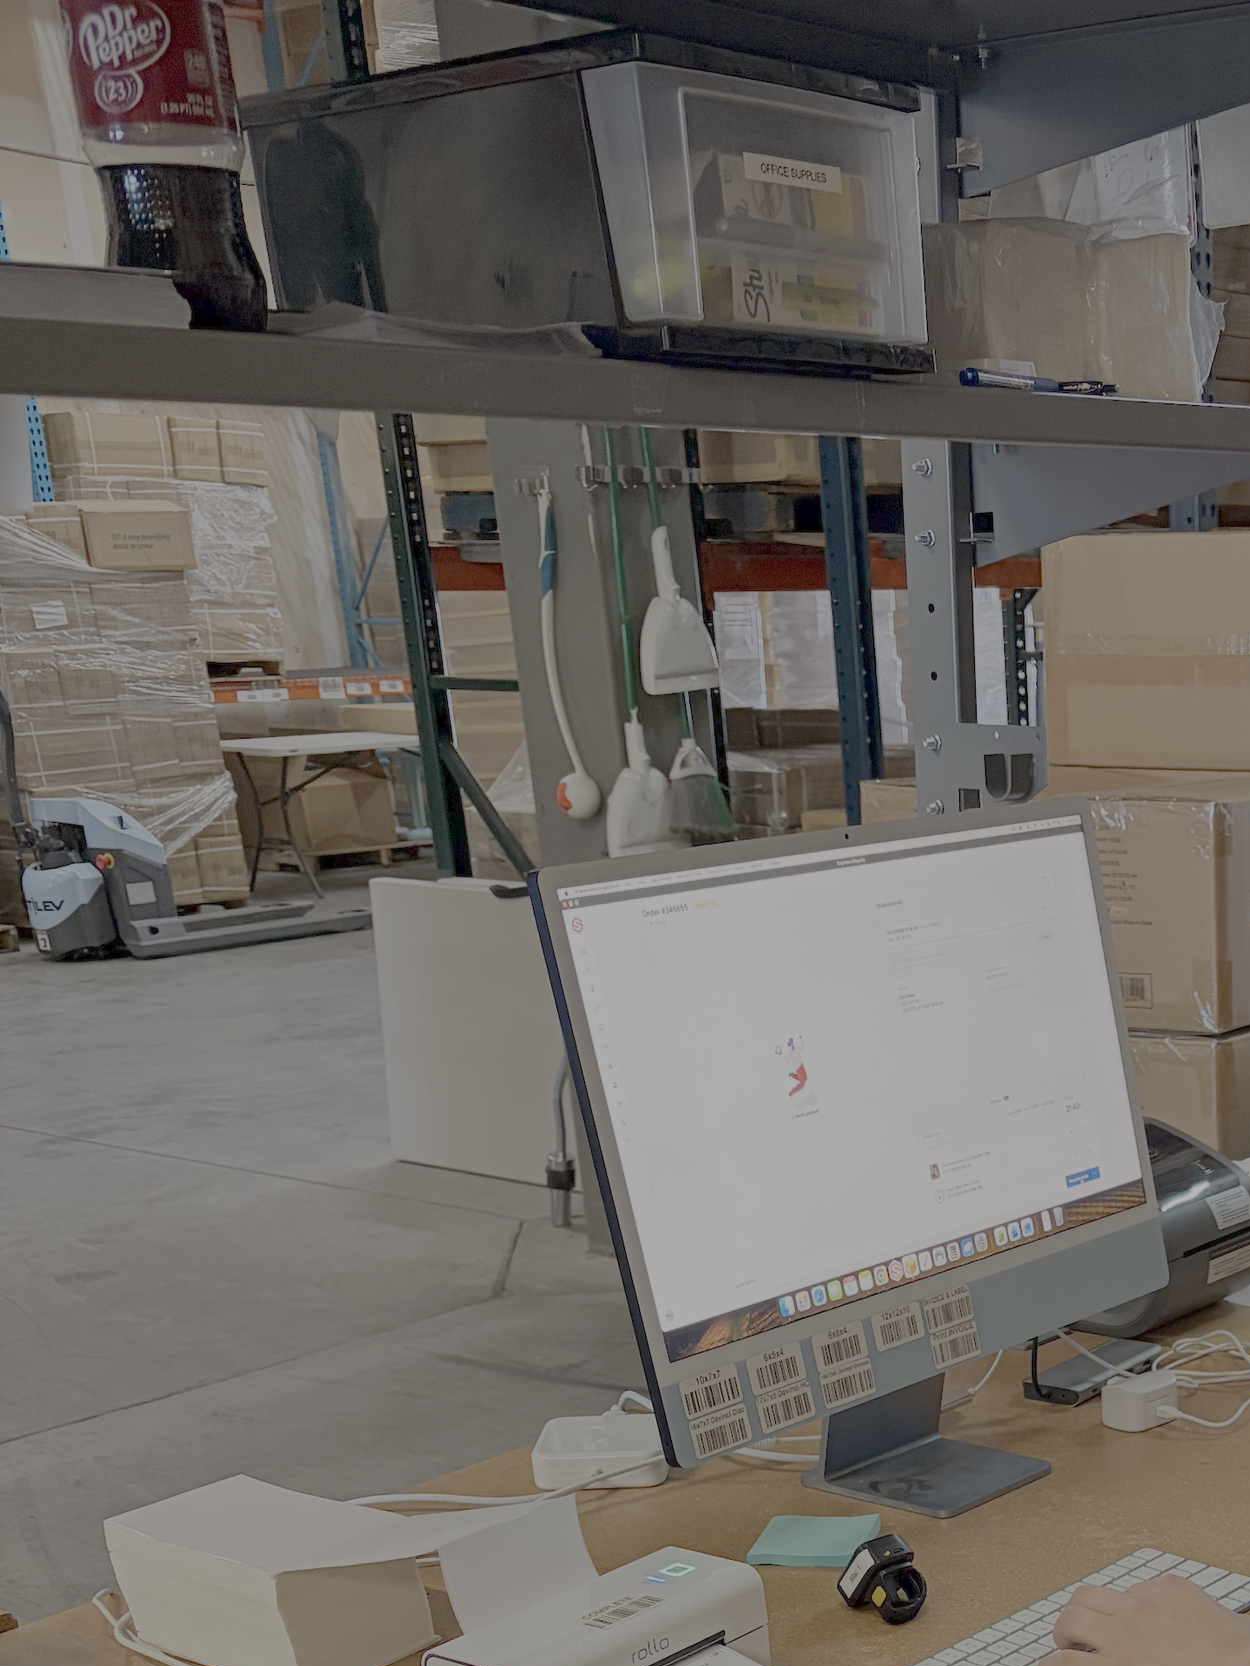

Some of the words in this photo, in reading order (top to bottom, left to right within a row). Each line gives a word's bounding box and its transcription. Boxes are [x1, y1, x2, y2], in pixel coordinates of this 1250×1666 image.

[102, 4, 137, 38] Dr
[86, 15, 164, 71] Pepper
[760, 162, 789, 178] OFFICE
[791, 167, 827, 183] SUPPLIES
[642, 909, 660, 918] Order
[924, 1294, 945, 1307] INVOICE
[951, 1286, 968, 1298] LABEL
[881, 1304, 911, 1322] 12x12x10
[933, 1329, 948, 1342] Print
[949, 1321, 974, 1338] INVOICE
[763, 1348, 785, 1362] 6x5x4
[695, 1369, 721, 1386] 10x7x7
[582, 1595, 635, 1620] COMPLETE
[631, 1637, 669, 1664] rollo
